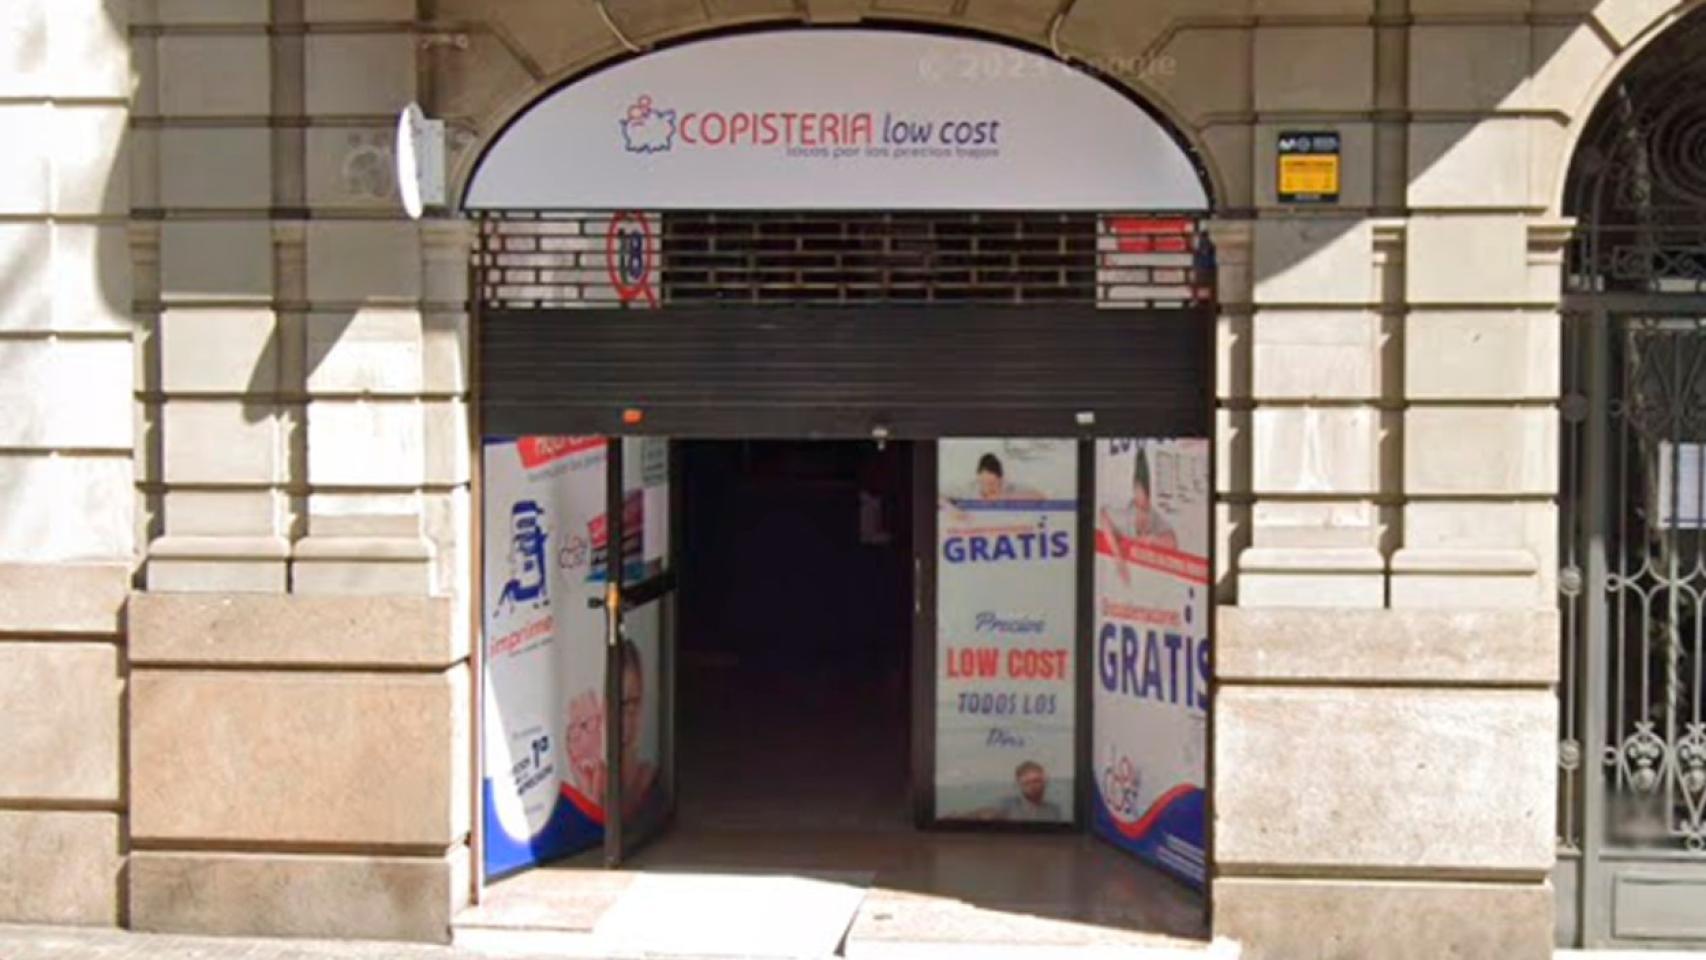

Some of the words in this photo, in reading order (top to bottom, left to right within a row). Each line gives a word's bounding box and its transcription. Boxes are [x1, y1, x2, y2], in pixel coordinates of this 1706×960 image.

[679, 112, 872, 145] COPISTERIA
[882, 112, 934, 144] low
[939, 120, 1000, 144] cost
[946, 648, 999, 679] LOW
[1007, 648, 1068, 680] COST
[957, 692, 1016, 715] TODOS
[1022, 693, 1057, 716] LOS
